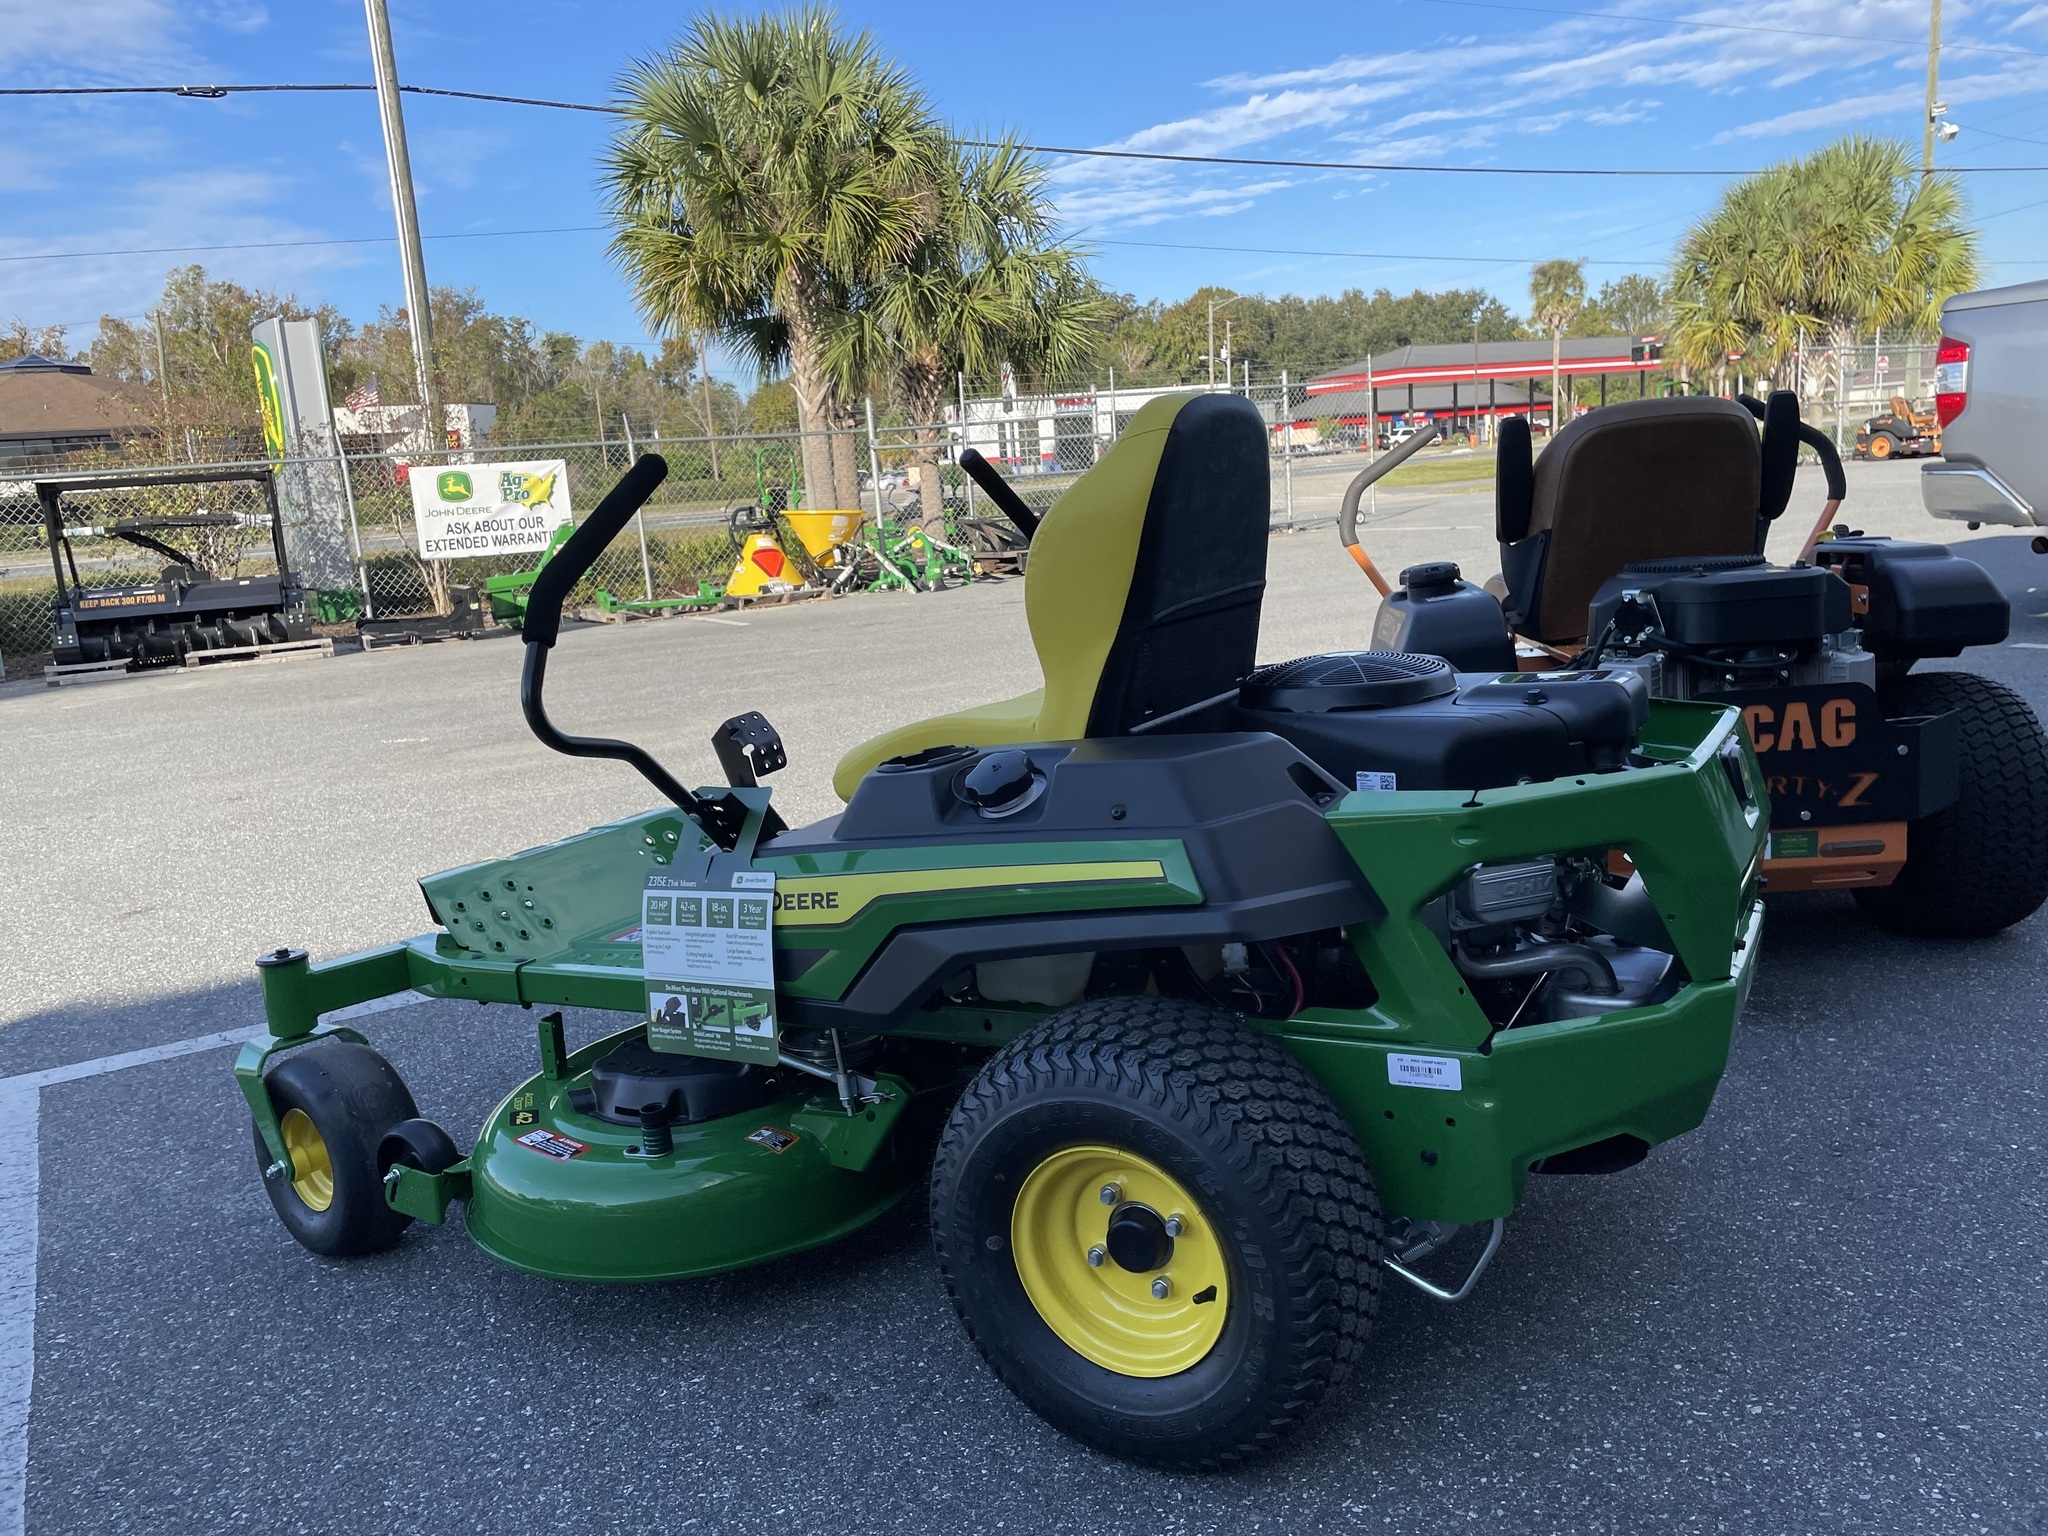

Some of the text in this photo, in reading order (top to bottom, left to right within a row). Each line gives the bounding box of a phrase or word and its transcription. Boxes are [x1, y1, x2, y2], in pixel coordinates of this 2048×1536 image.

[500, 472, 528, 488] Ag-
[502, 488, 530, 502] Pro
[425, 506, 492, 518] JOHN DEERE
[446, 516, 544, 535] ASK ABOUT OUR
[425, 535, 489, 553] EXTENDED
[80, 600, 98, 609] KEEP
[100, 598, 120, 607] BACK
[121, 597, 135, 605] 300
[157, 594, 166, 602] M
[1742, 698, 1857, 753] CAG
[1503, 875, 1553, 897] OHV
[650, 900, 668, 910] 20 HP
[773, 891, 839, 911] DEERE
[743, 904, 762, 914] 3 Year
[516, 1112, 533, 1125] 42
